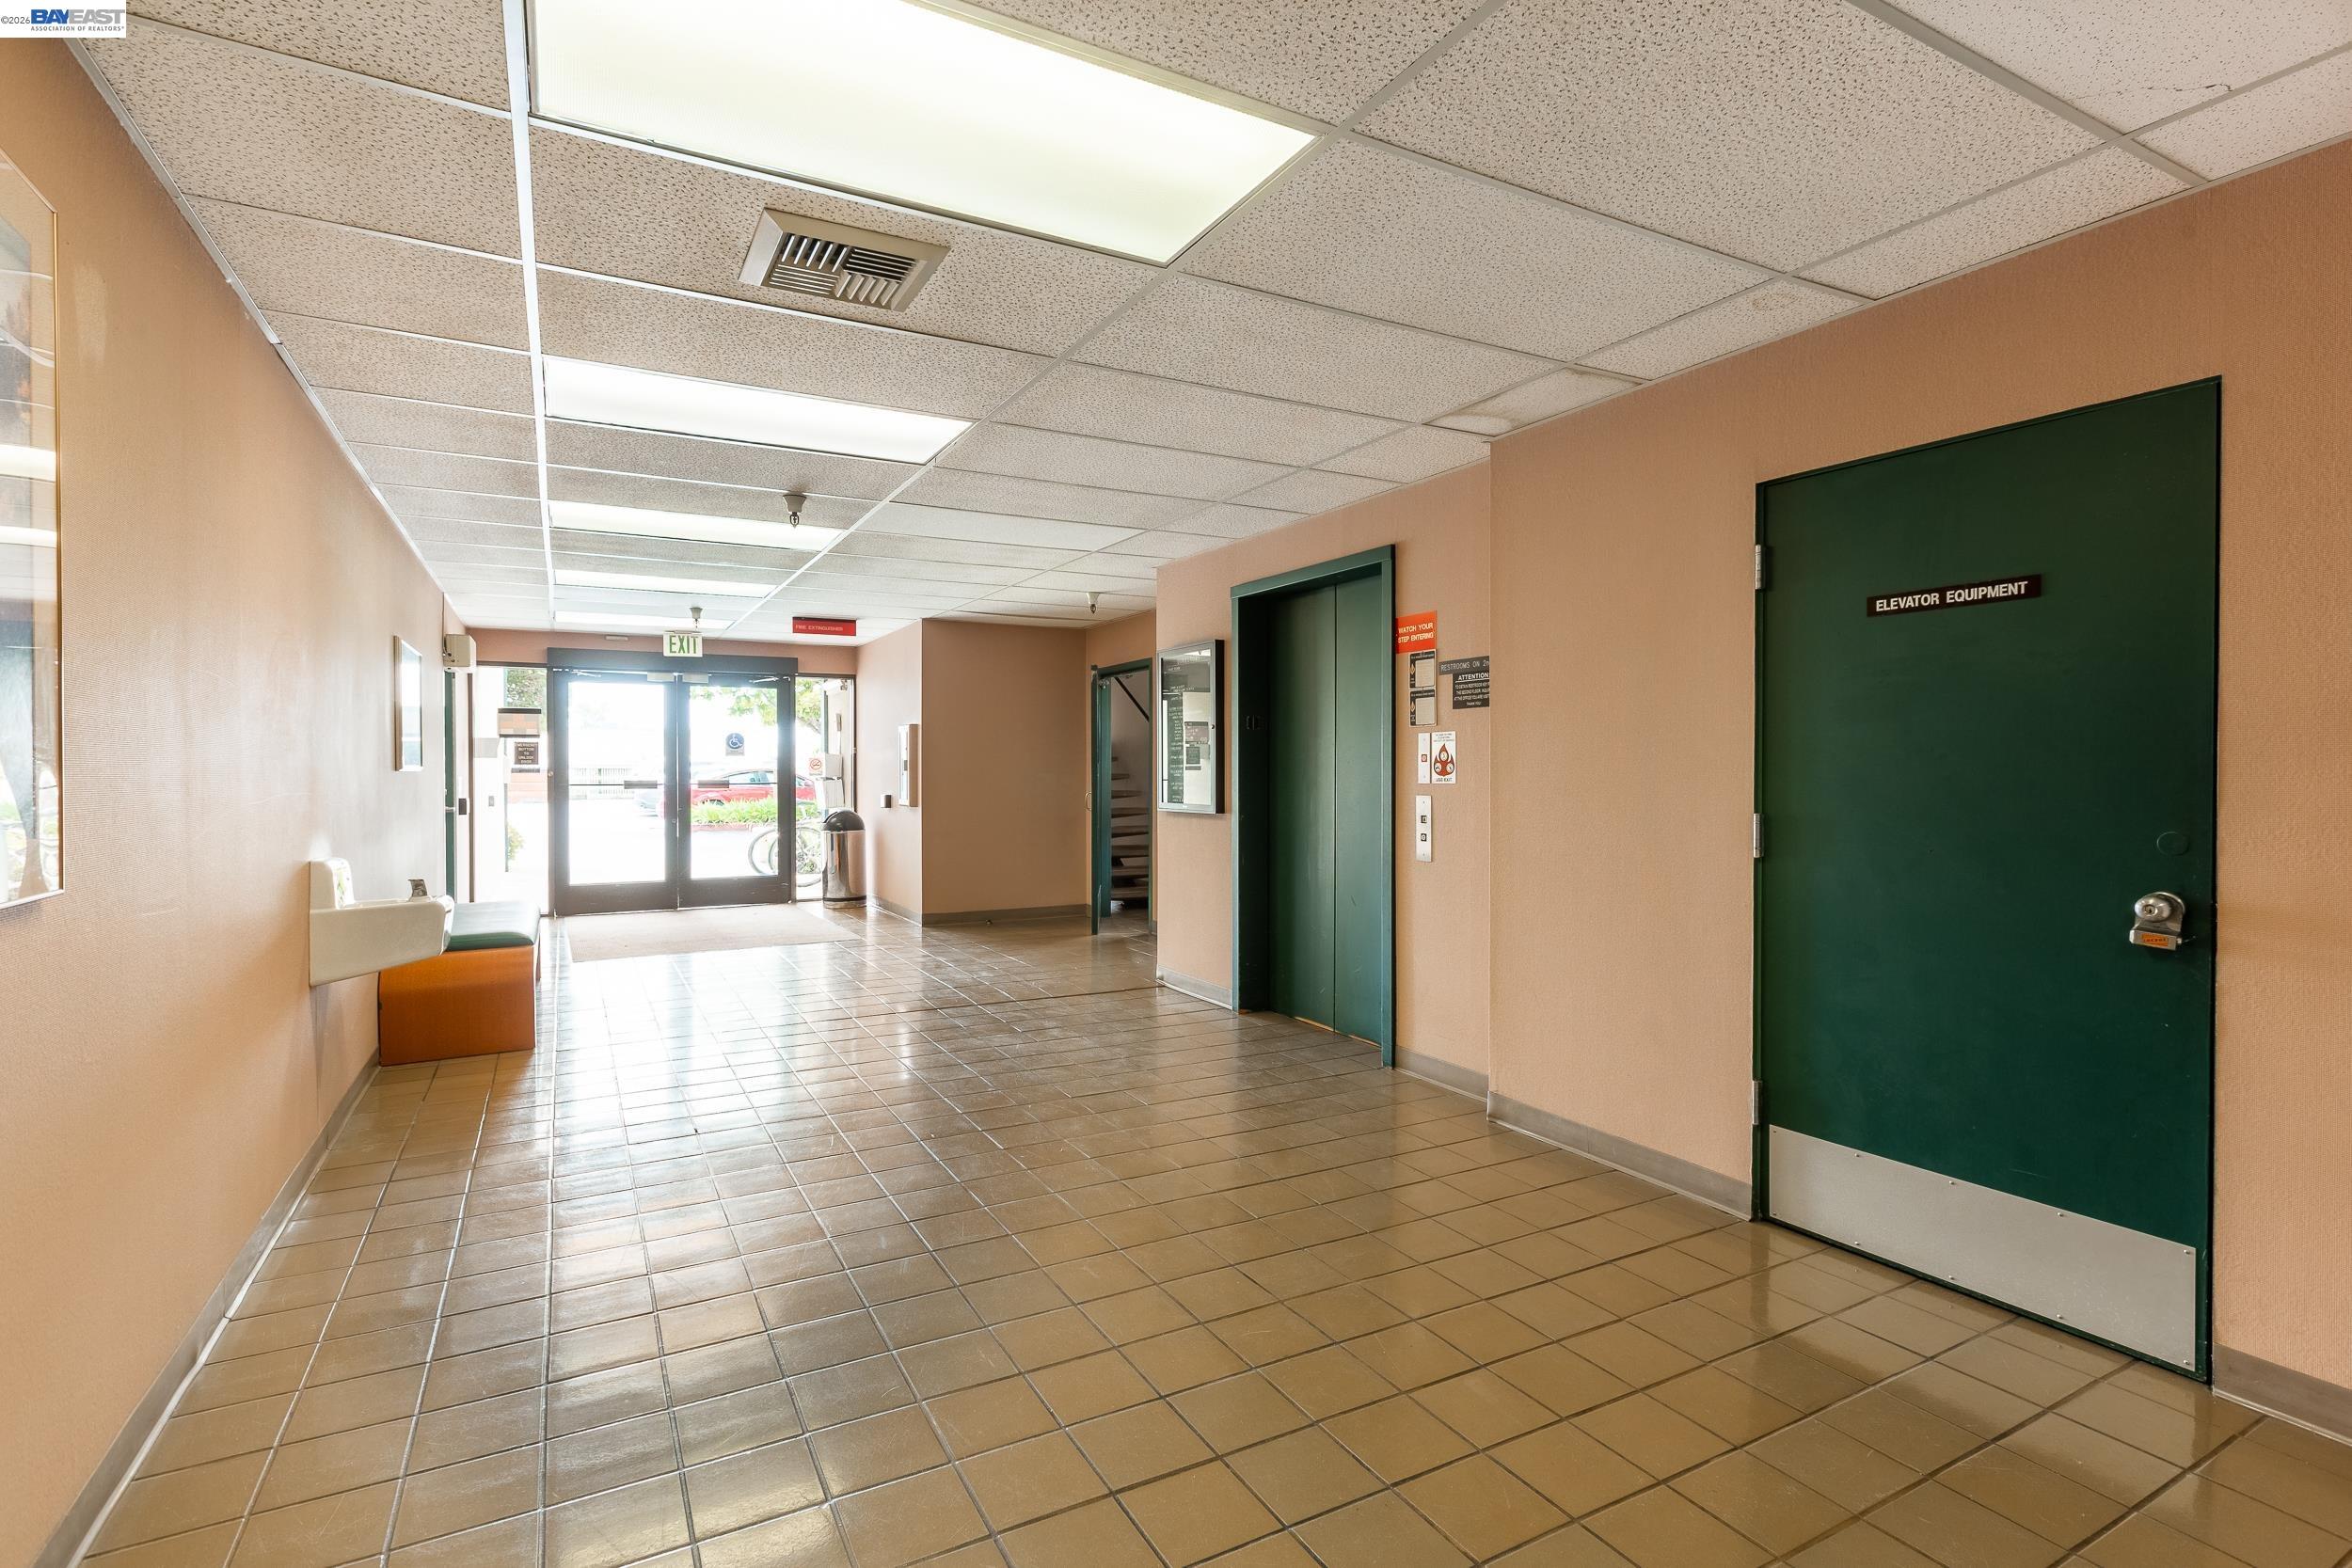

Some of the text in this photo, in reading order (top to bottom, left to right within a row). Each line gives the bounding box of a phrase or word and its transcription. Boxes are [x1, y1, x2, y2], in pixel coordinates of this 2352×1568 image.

[1876, 580, 2028, 611] ELEVATOR EQUIPMENT
[1418, 622, 1434, 630] YOUR
[1411, 632, 1434, 641] ENTERING
[669, 635, 698, 654] EXIT
[1440, 661, 1470, 672] RESTROOMS
[1458, 673, 1488, 681] ATTENTION
